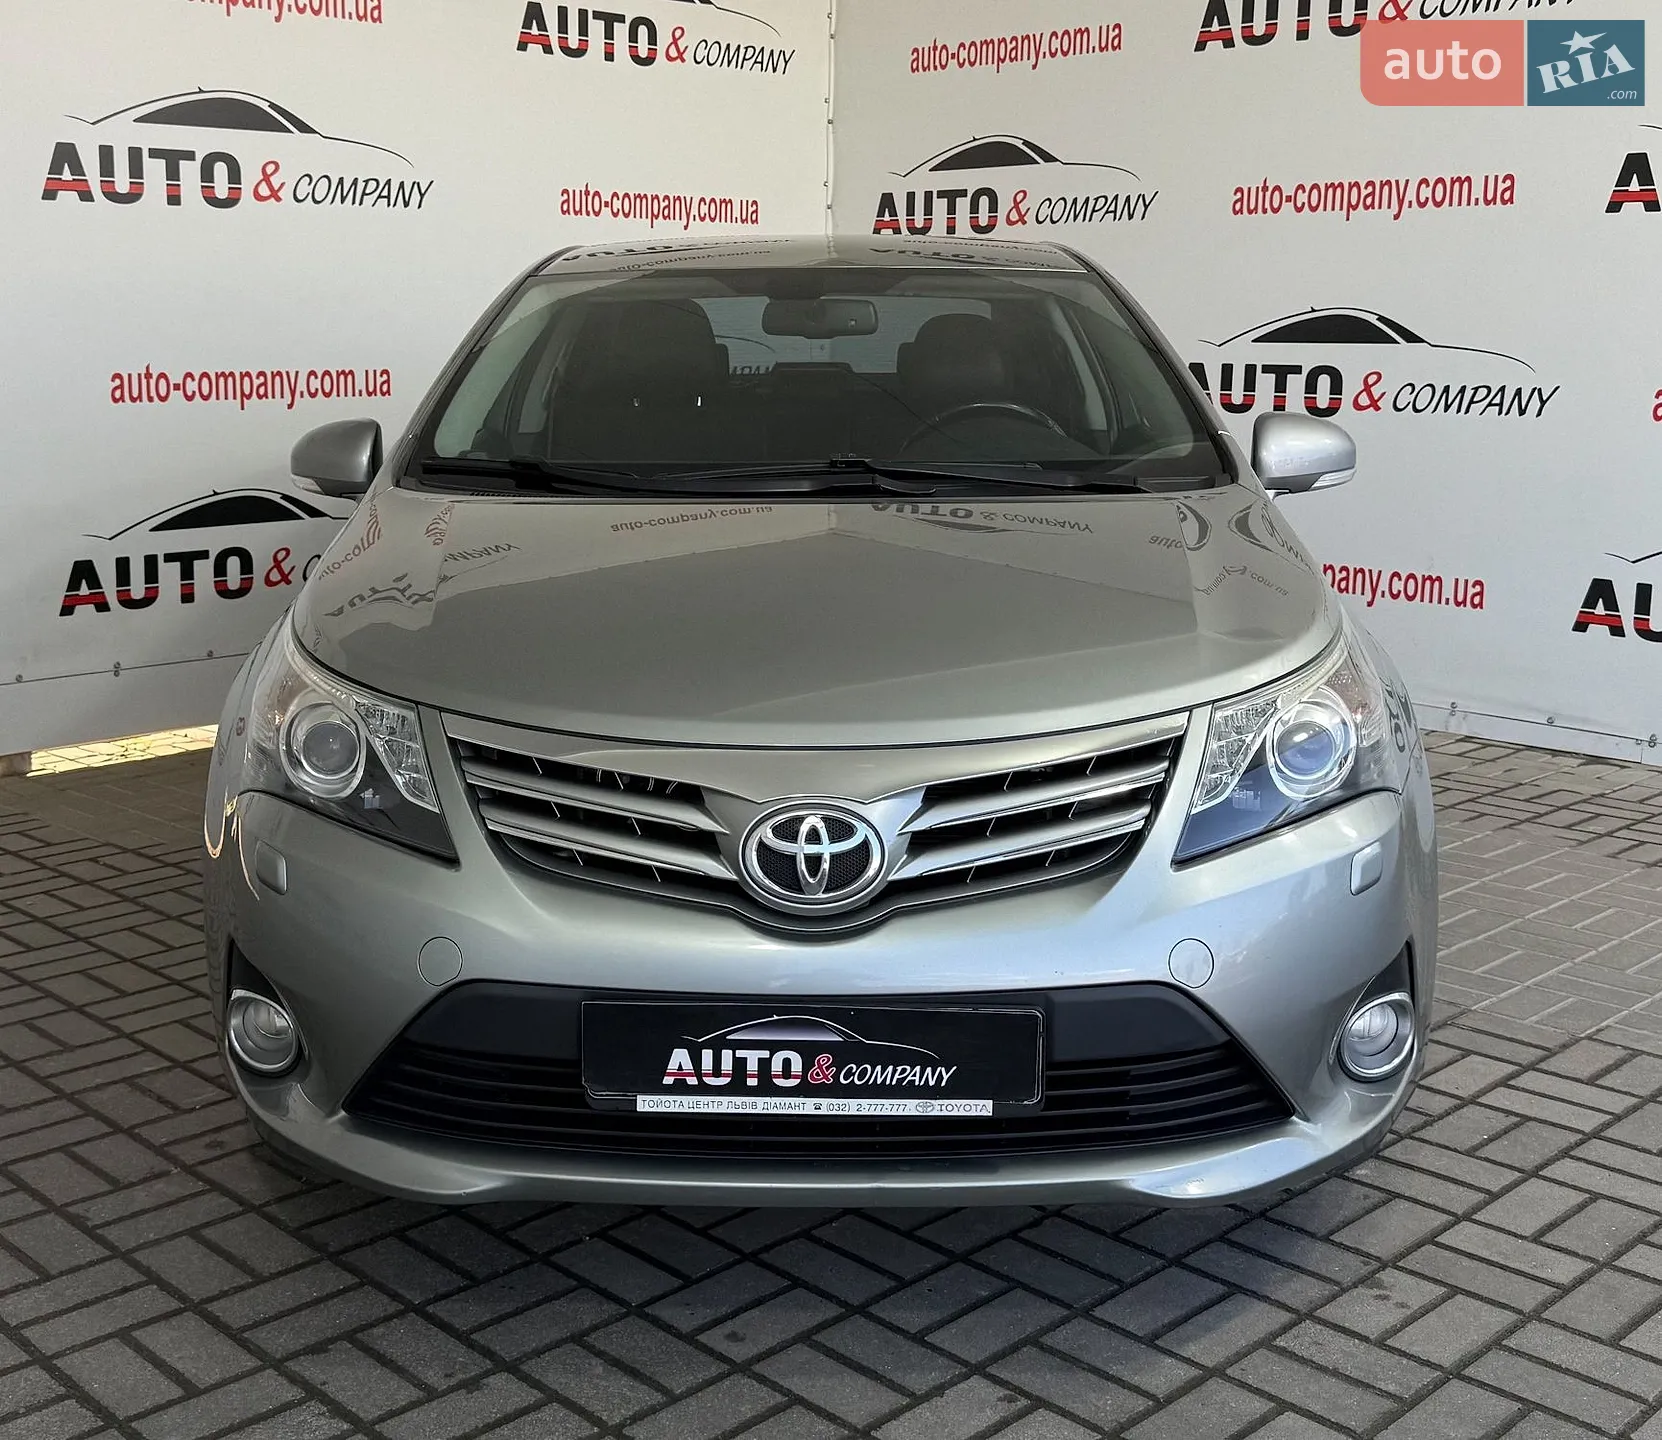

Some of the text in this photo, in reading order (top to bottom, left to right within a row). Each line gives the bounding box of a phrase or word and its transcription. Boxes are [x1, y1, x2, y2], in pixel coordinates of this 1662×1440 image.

[517, 1, 795, 75] AUTO & COMPANY
[911, 23, 1122, 73] auto-company.com.ua
[41, 142, 434, 209] AUTO & COMPANY
[1232, 174, 1516, 221] auto-company.com.ua
[561, 182, 759, 230] auto-company.com.ua
[872, 187, 1159, 235] AUTO & COMPANY
[111, 364, 391, 410] auto-company.com.ua
[1353, 371, 1387, 412] &
[1392, 383, 1560, 418] COMPANY
[59, 547, 254, 617] AUTO
[264, 548, 296, 587] &
[662, 1049, 957, 1087] AUTO & COMPANY
[641, 1099, 990, 1113] ТОЙОТА ЦЕНТР ЛЬВІВ ДІАМАНТ (032) 2-777-777 TOYOTA
